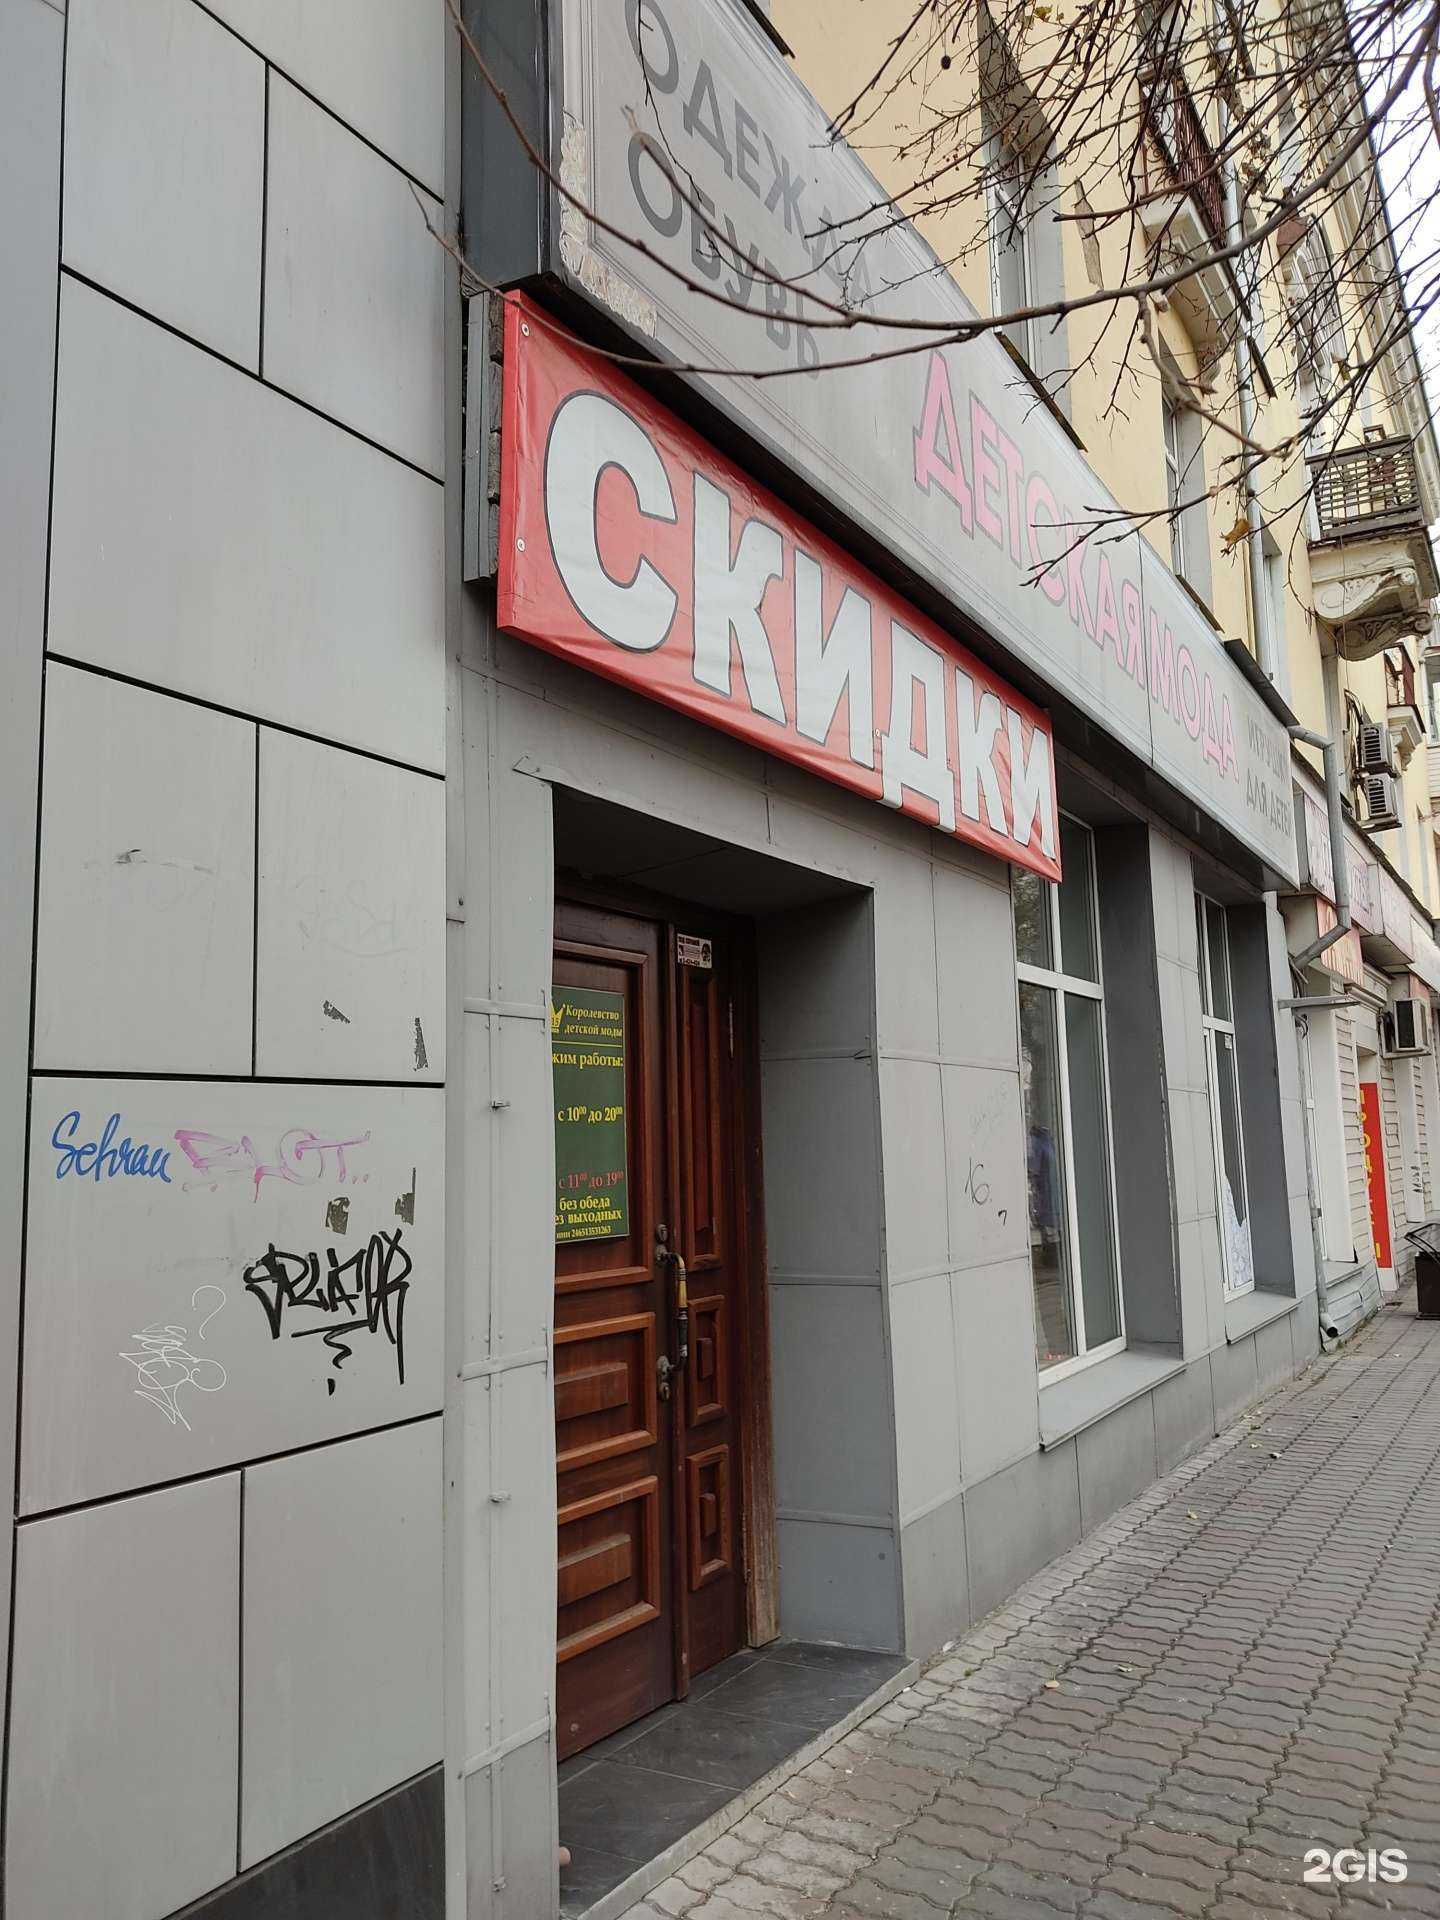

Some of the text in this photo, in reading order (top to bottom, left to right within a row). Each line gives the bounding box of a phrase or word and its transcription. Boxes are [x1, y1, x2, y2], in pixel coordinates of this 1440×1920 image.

[628, 131, 820, 380] ОБУВЬ
[913, 349, 1241, 784] ДЕТСКАЯ МОДА
[543, 388, 1057, 862] СКИДКИ
[565, 1004, 620, 1021] Королевство
[564, 1024, 599, 1036] детской
[601, 1027, 623, 1038] моды
[551, 1052, 577, 1065] жим
[588, 1109, 602, 1123] до
[589, 1176, 603, 1189] до
[559, 1195, 611, 1211] без обеда
[567, 1209, 622, 1224] выходных
